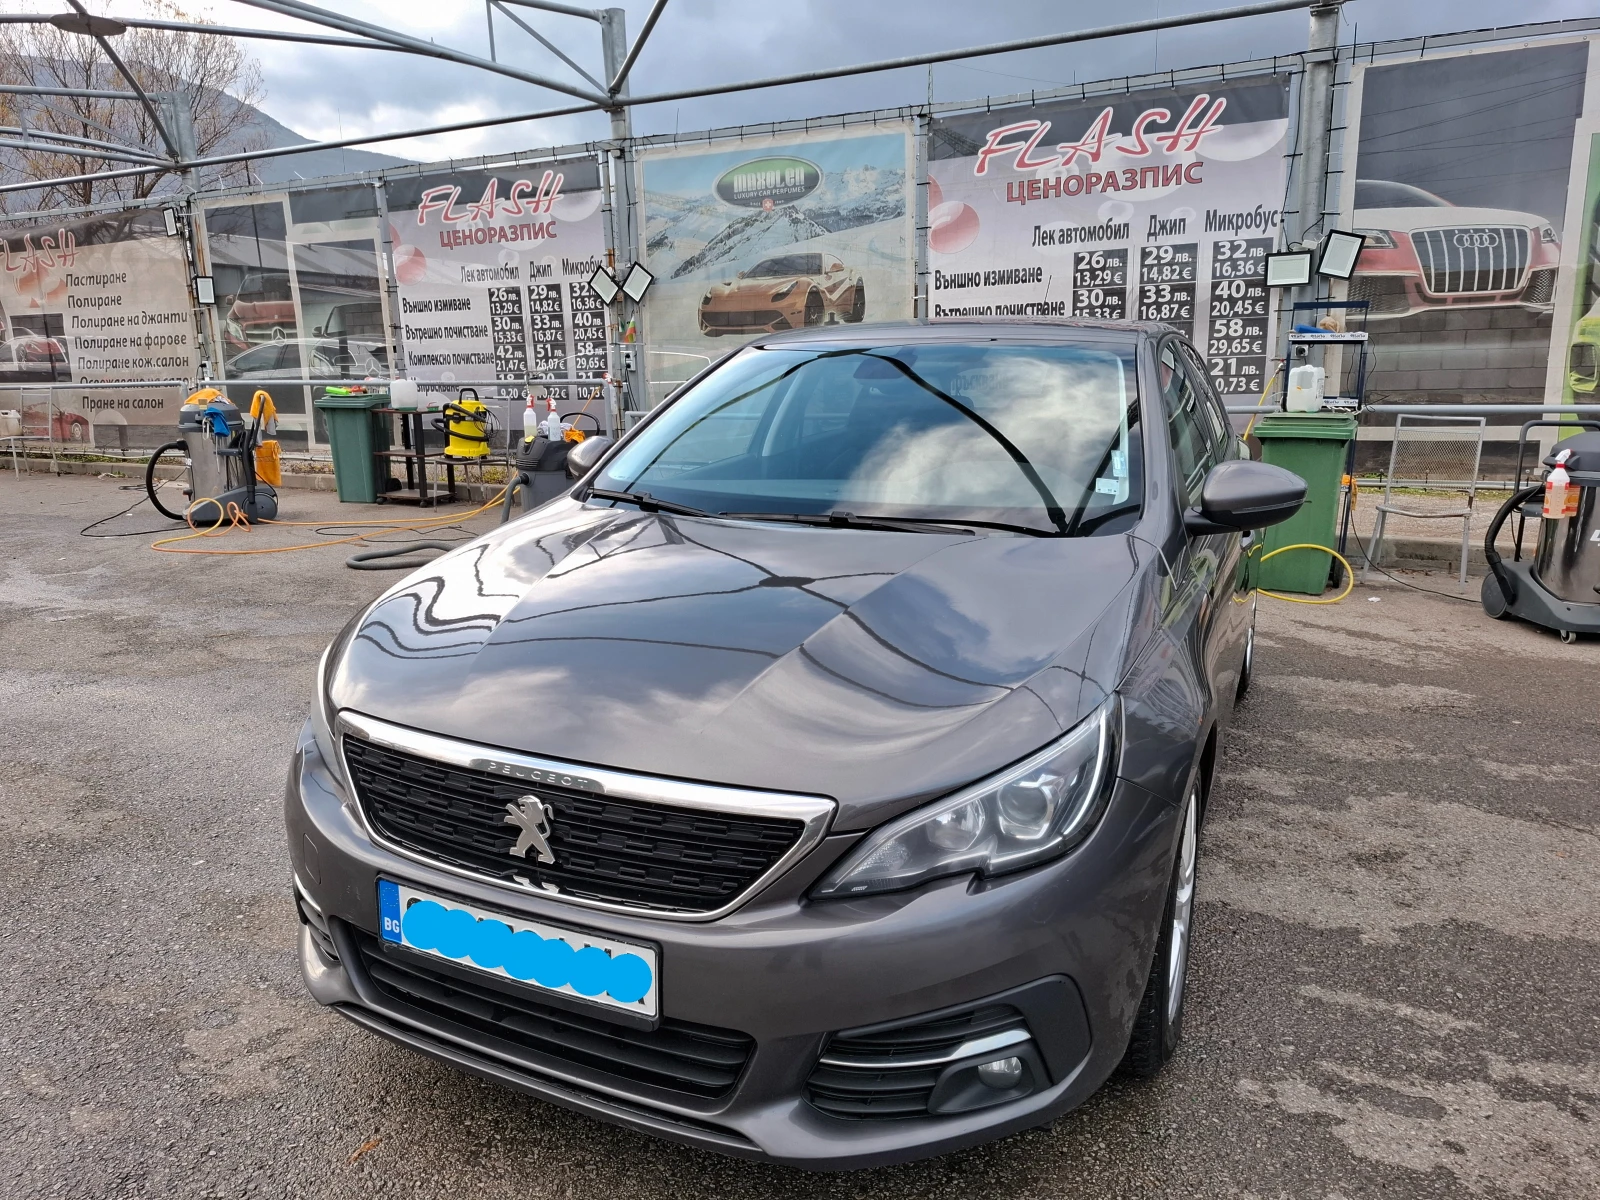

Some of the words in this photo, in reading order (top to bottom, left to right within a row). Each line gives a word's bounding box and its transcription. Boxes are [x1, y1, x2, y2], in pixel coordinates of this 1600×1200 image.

[974, 93, 1227, 176] FLASH
[1006, 161, 1203, 206] ЦЕНОРАЗПИС
[418, 170, 565, 226] FLASH
[734, 191, 758, 200] LUXURY
[773, 185, 805, 195] PERFUMES
[1147, 214, 1186, 242] Джип
[1204, 204, 1278, 236] Микробус
[439, 221, 557, 250] ЦЕНОРАЗПИС
[1032, 225, 1056, 248] Лек
[1058, 217, 1130, 245] автомобил
[0, 228, 80, 273] LASH
[1144, 246, 1173, 265] 29
[1175, 253, 1192, 263] лв.
[1217, 240, 1247, 260] 32
[1077, 251, 1105, 270] 26
[1106, 258, 1123, 267] лв.
[1214, 260, 1254, 277] 16,36
[460, 265, 476, 283] Лек
[476, 262, 520, 282] автомобил
[530, 260, 552, 282] Джип
[934, 269, 981, 290] Външно
[984, 266, 1042, 287] измиване
[1075, 270, 1112, 288] 13,29
[1114, 271, 1123, 284] €
[1141, 265, 1180, 283] 14,82
[1182, 266, 1192, 279] €
[65, 272, 127, 288] Пастиране
[490, 288, 507, 302] 26
[508, 293, 519, 301] лв.
[530, 285, 548, 300] 29
[572, 282, 590, 297] 32
[1077, 289, 1104, 307] 30
[1105, 296, 1122, 305] лв.
[1143, 284, 1171, 303] 33
[1174, 291, 1191, 301] лв.
[1215, 280, 1246, 299] 40
[1247, 287, 1265, 297] лв.
[68, 295, 122, 310] Полиране
[402, 297, 432, 314] Външно
[434, 297, 471, 312] измиване
[490, 302, 513, 315] 13,29
[530, 300, 553, 313] 14,82
[572, 298, 595, 311] 16,36
[1211, 299, 1253, 318] 20,45
[1254, 301, 1265, 314] €
[72, 315, 125, 331] Полиране
[127, 314, 140, 326] на
[142, 311, 188, 324] джанти
[574, 312, 592, 326] 40
[592, 318, 603, 326] лв.
[1140, 304, 1178, 321] 16,87
[1180, 305, 1190, 318] €
[494, 316, 511, 330] 30
[533, 315, 550, 328] 33
[1213, 318, 1243, 338] 58
[1244, 326, 1263, 336] лв.
[74, 336, 128, 352] Полиране
[130, 336, 142, 348] на
[144, 332, 187, 350] фарове
[405, 324, 442, 344] Вътрешно
[444, 325, 488, 339] почистване
[494, 331, 516, 344] 15,33
[534, 330, 556, 343] 16,87
[574, 328, 598, 342] 20,45
[496, 345, 514, 359] 42
[536, 344, 552, 358] 51
[577, 342, 594, 356] 58
[1209, 339, 1250, 356] 29,65
[1252, 340, 1263, 353] €
[78, 356, 130, 372] Полиране
[408, 351, 452, 366] Комплексно
[452, 352, 494, 365] почистване
[496, 360, 519, 372] 21,47
[536, 359, 558, 371] 26,07
[576, 358, 600, 370] 29,65
[1210, 358, 1237, 376] 21
[1241, 365, 1260, 375] лв.
[500, 388, 519, 400] 9,20
[538, 388, 560, 400] 0,22
[1215, 377, 1247, 394] 0,73
[1249, 379, 1260, 392] €
[82, 396, 115, 412] Пране
[117, 399, 128, 409] на
[132, 398, 164, 409] салон
[384, 916, 400, 934] BG
